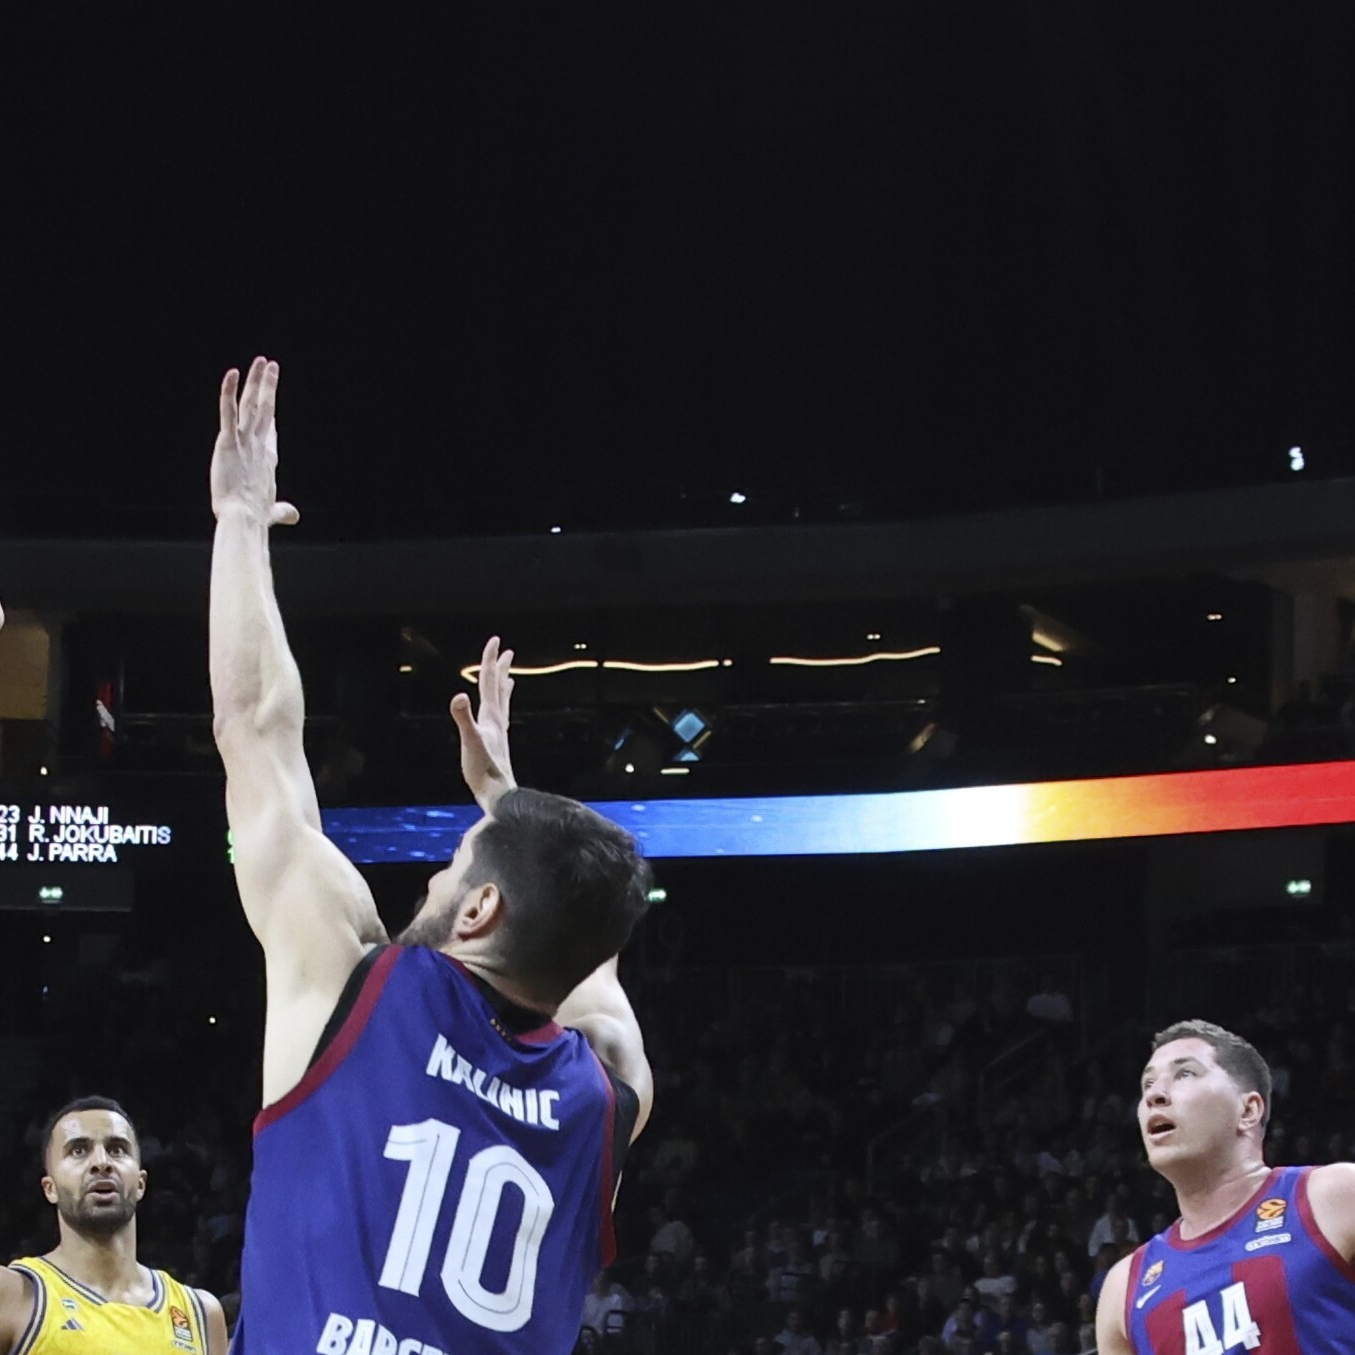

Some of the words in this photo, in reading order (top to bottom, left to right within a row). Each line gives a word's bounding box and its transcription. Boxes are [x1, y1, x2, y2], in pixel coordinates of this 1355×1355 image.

[28, 805, 45, 824] J.
[49, 806, 109, 825] NNAJI
[29, 824, 49, 843] R.
[53, 825, 171, 844] JOKUBAITIS
[26, 843, 44, 862] J.
[49, 844, 118, 863] PARRA
[425, 1032, 561, 1132] KALINIC
[377, 1117, 556, 1333] 10
